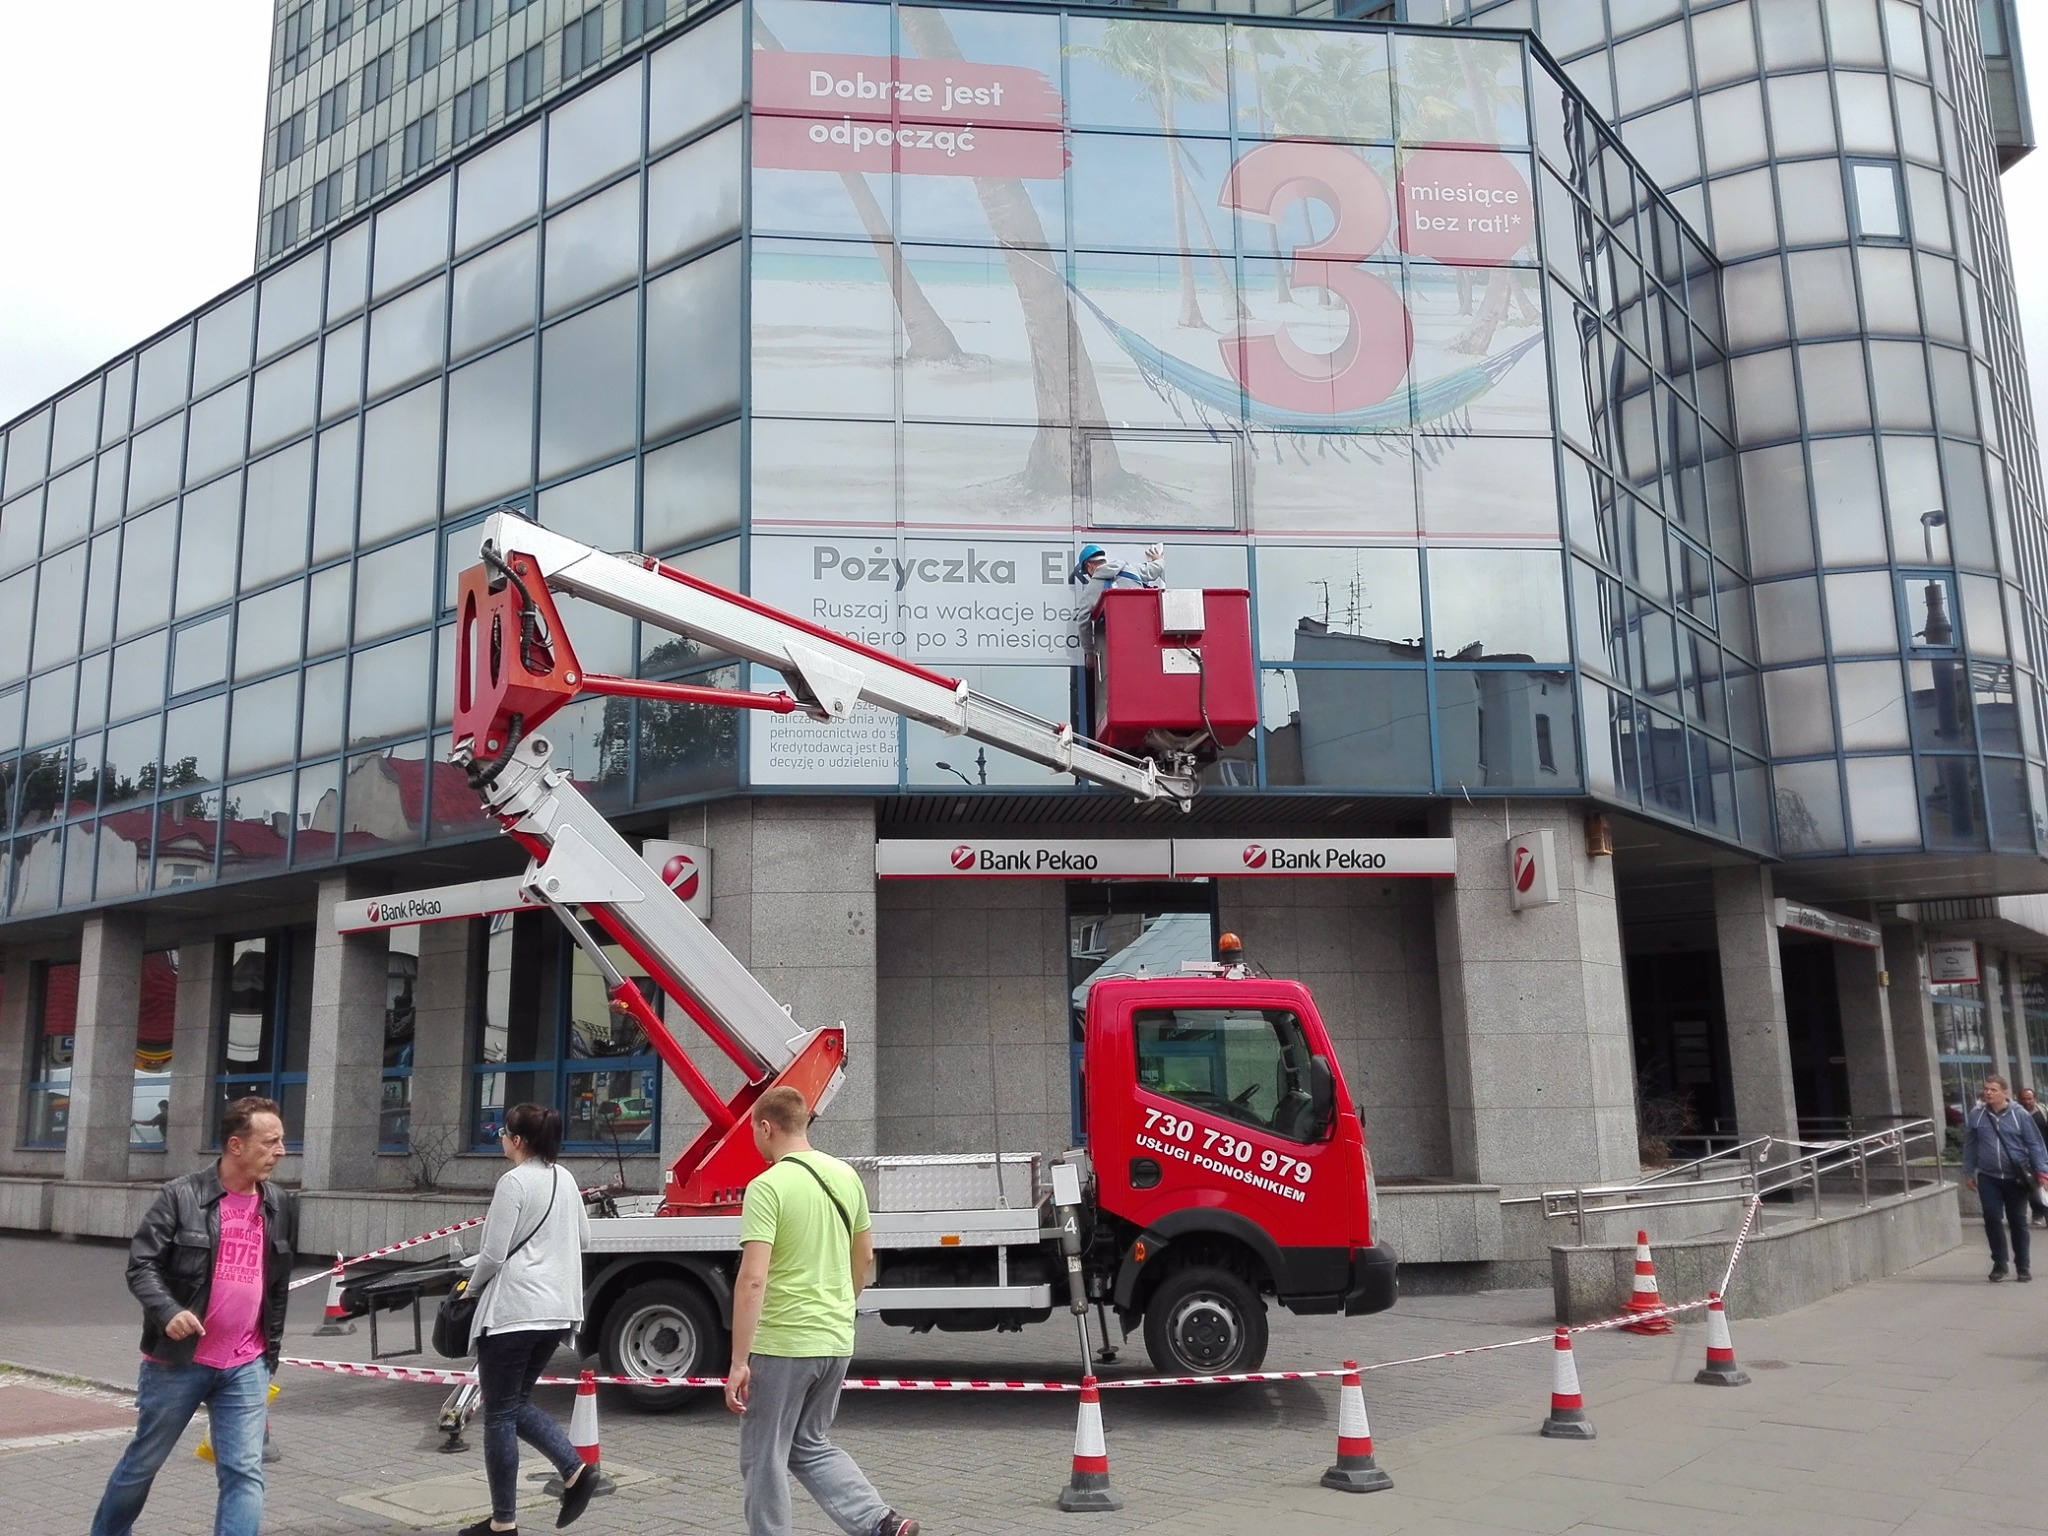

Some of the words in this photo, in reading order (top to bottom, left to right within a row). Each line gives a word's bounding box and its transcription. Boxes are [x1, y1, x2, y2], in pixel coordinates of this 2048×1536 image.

[809, 70, 933, 102] Dobrze
[941, 77, 1004, 112] jest
[808, 115, 975, 157] odpocząć
[1410, 181, 1519, 208] miesiące
[1415, 210, 1459, 231] bez
[1216, 140, 1414, 414] 3
[813, 546, 1016, 592] Pożyczka
[812, 598, 888, 625] Ruszaj
[897, 604, 928, 620] na
[936, 601, 1034, 627] wakacje
[916, 631, 947, 653] po
[955, 628, 968, 648] 3
[849, 714, 875, 725] dnia
[769, 727, 868, 740] pełnomocnictwa
[871, 727, 886, 740] do
[769, 741, 853, 756] Kredytodawcą
[854, 742, 877, 756] jest
[769, 756, 813, 771] decyzję
[817, 760, 826, 769] o
[828, 756, 889, 769] udzieleniu
[980, 849, 1031, 871] Bank
[1035, 849, 1098, 871] Pekao
[1271, 848, 1320, 870] Bank
[1325, 848, 1386, 870] Pekao
[381, 902, 409, 922] Bank
[409, 899, 442, 918] Pekao
[1144, 1107, 1194, 1142] 730
[1202, 1128, 1253, 1163] 730
[1259, 1150, 1312, 1184] 979
[1136, 1133, 1190, 1162] USŁUGI
[1192, 1153, 1306, 1203] PODNOŚNIKIEM
[1064, 1216, 1077, 1235] 4
[216, 1240, 258, 1267] 1976
